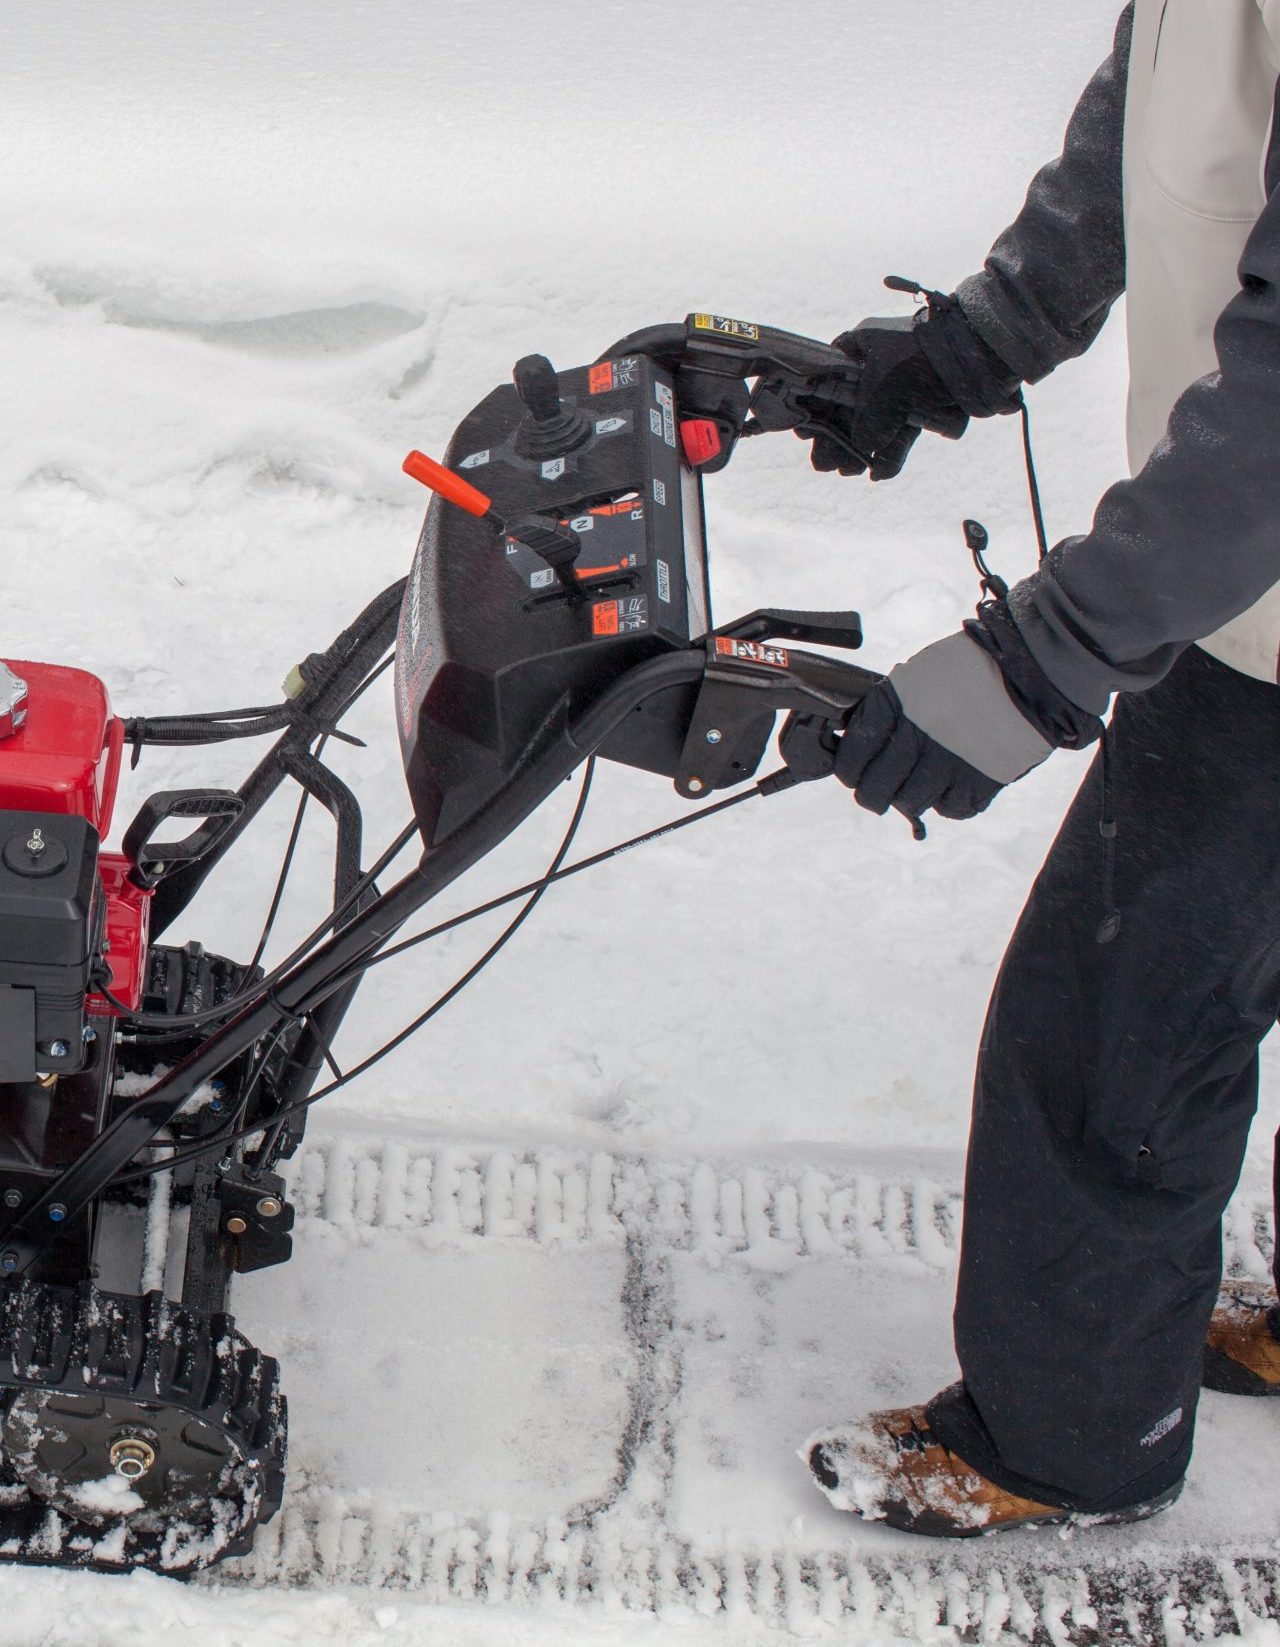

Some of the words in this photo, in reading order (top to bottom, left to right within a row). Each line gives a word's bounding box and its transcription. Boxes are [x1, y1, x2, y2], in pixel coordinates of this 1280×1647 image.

[655, 480, 665, 504] SPEED
[631, 510, 643, 520] R
[577, 519, 588, 529] N
[506, 544, 518, 555] F
[659, 562, 669, 603] THROTTLE
